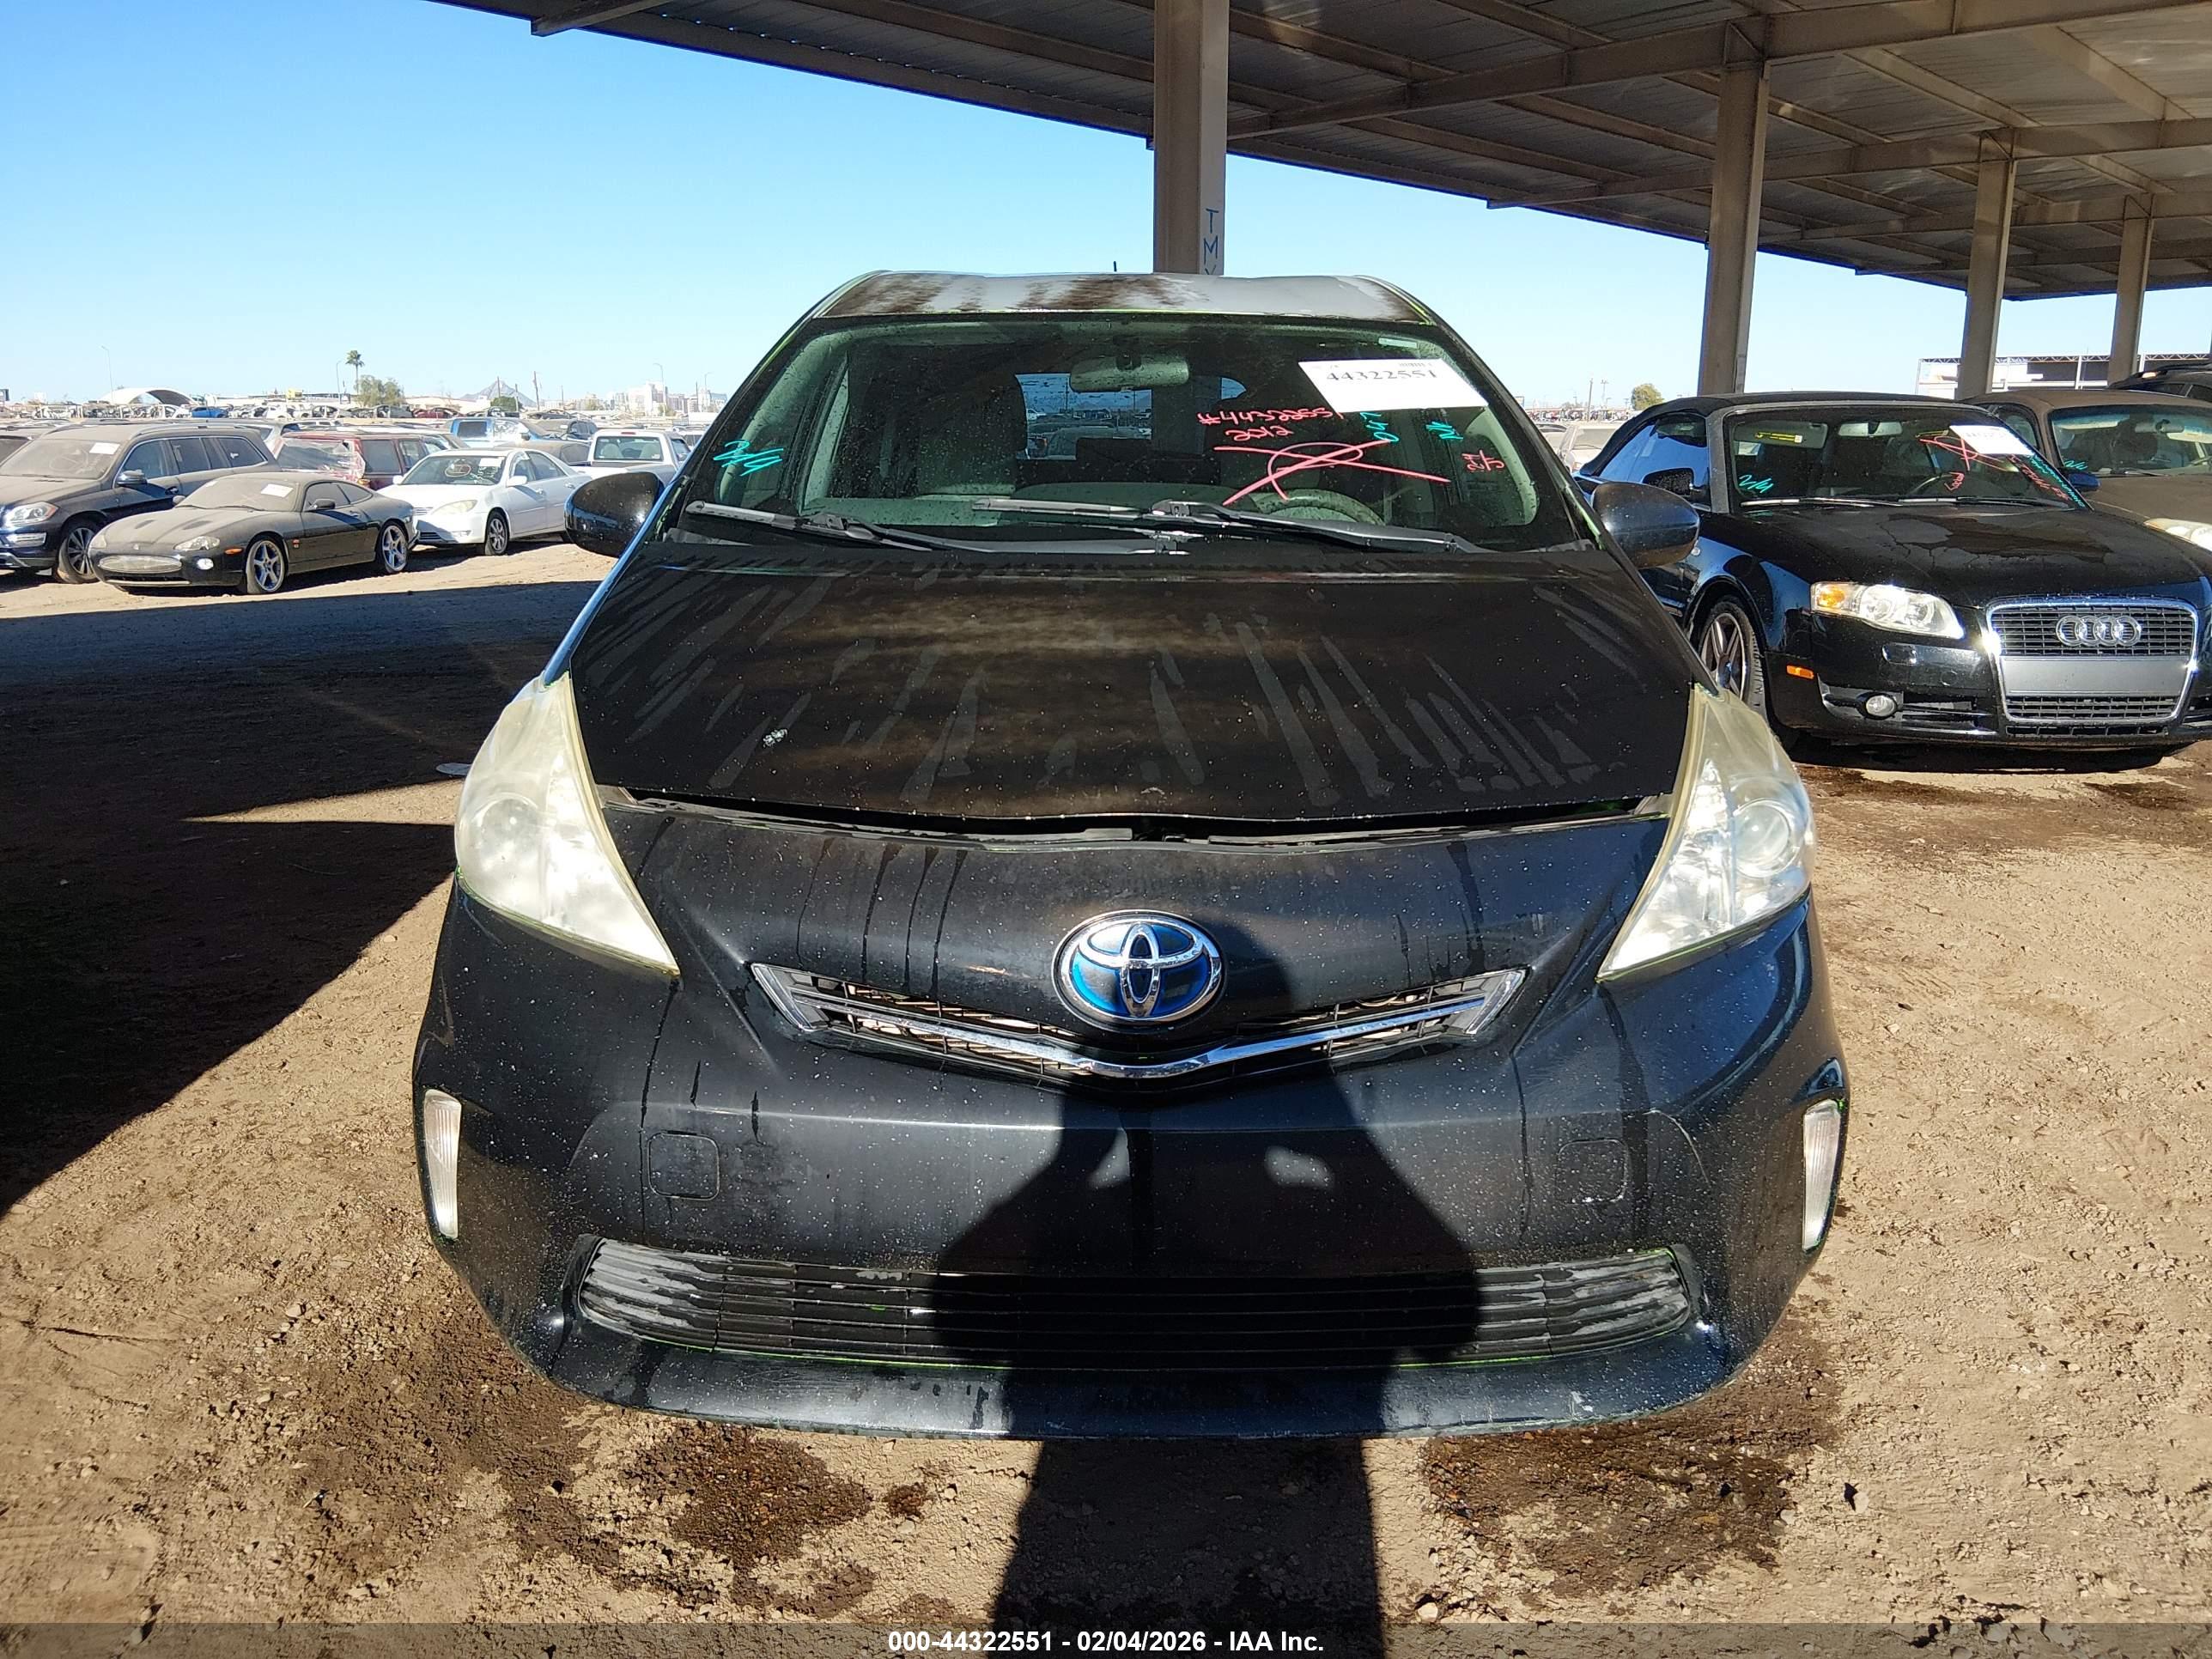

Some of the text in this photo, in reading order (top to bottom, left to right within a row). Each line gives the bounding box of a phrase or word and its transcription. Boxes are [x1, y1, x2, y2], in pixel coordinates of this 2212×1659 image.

[1326, 369, 1437, 381] 44322551
[1224, 425, 1295, 441] 2012
[1738, 474, 1774, 494] 2/4
